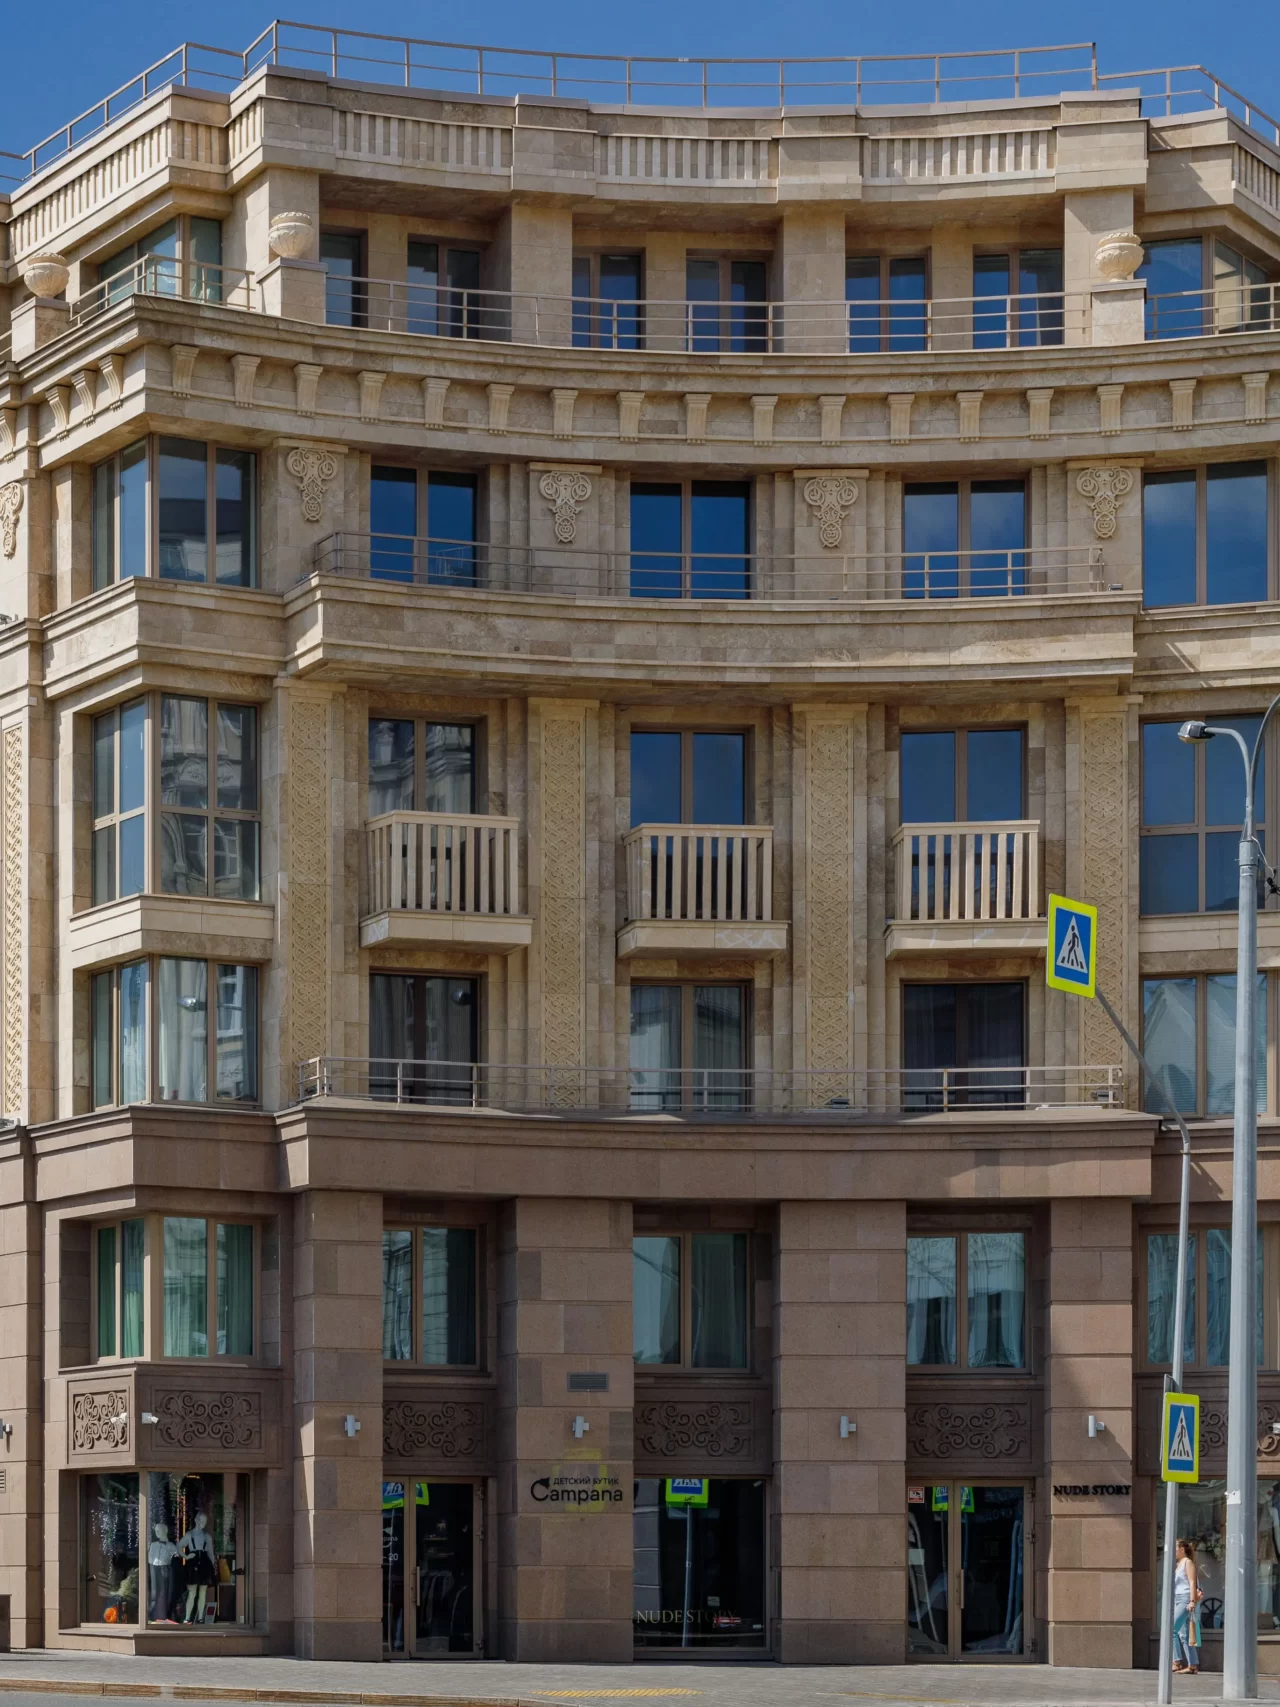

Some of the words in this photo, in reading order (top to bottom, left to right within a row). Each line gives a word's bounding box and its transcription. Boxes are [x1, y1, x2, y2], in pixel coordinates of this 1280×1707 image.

[553, 1476, 591, 1485] ДЕТСКИЙ
[593, 1477, 619, 1485] БУТИК
[530, 1477, 623, 1505] Campana
[1053, 1485, 1090, 1496] NUDE
[1092, 1484, 1132, 1496] STORY
[636, 1610, 683, 1624] NUDE
